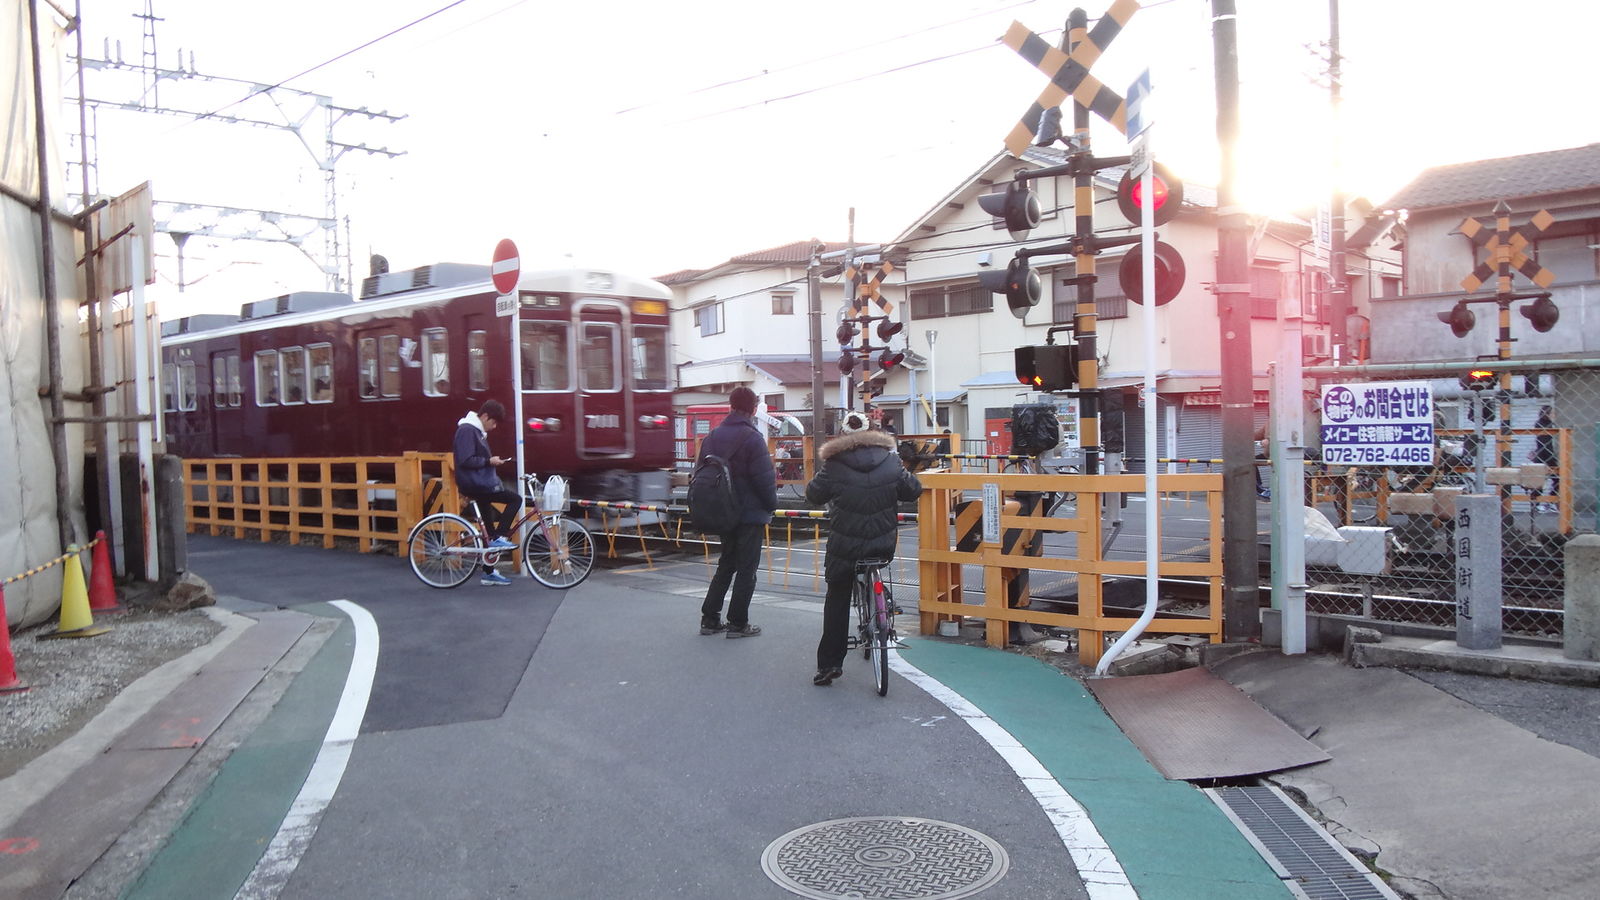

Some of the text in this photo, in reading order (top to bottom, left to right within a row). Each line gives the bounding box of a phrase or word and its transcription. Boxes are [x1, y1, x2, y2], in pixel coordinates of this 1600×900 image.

[1327, 391, 1352, 404] この
[1324, 426, 1431, 442] メイコー住宅情報サービス
[1458, 508, 1472, 620] 西国街道
